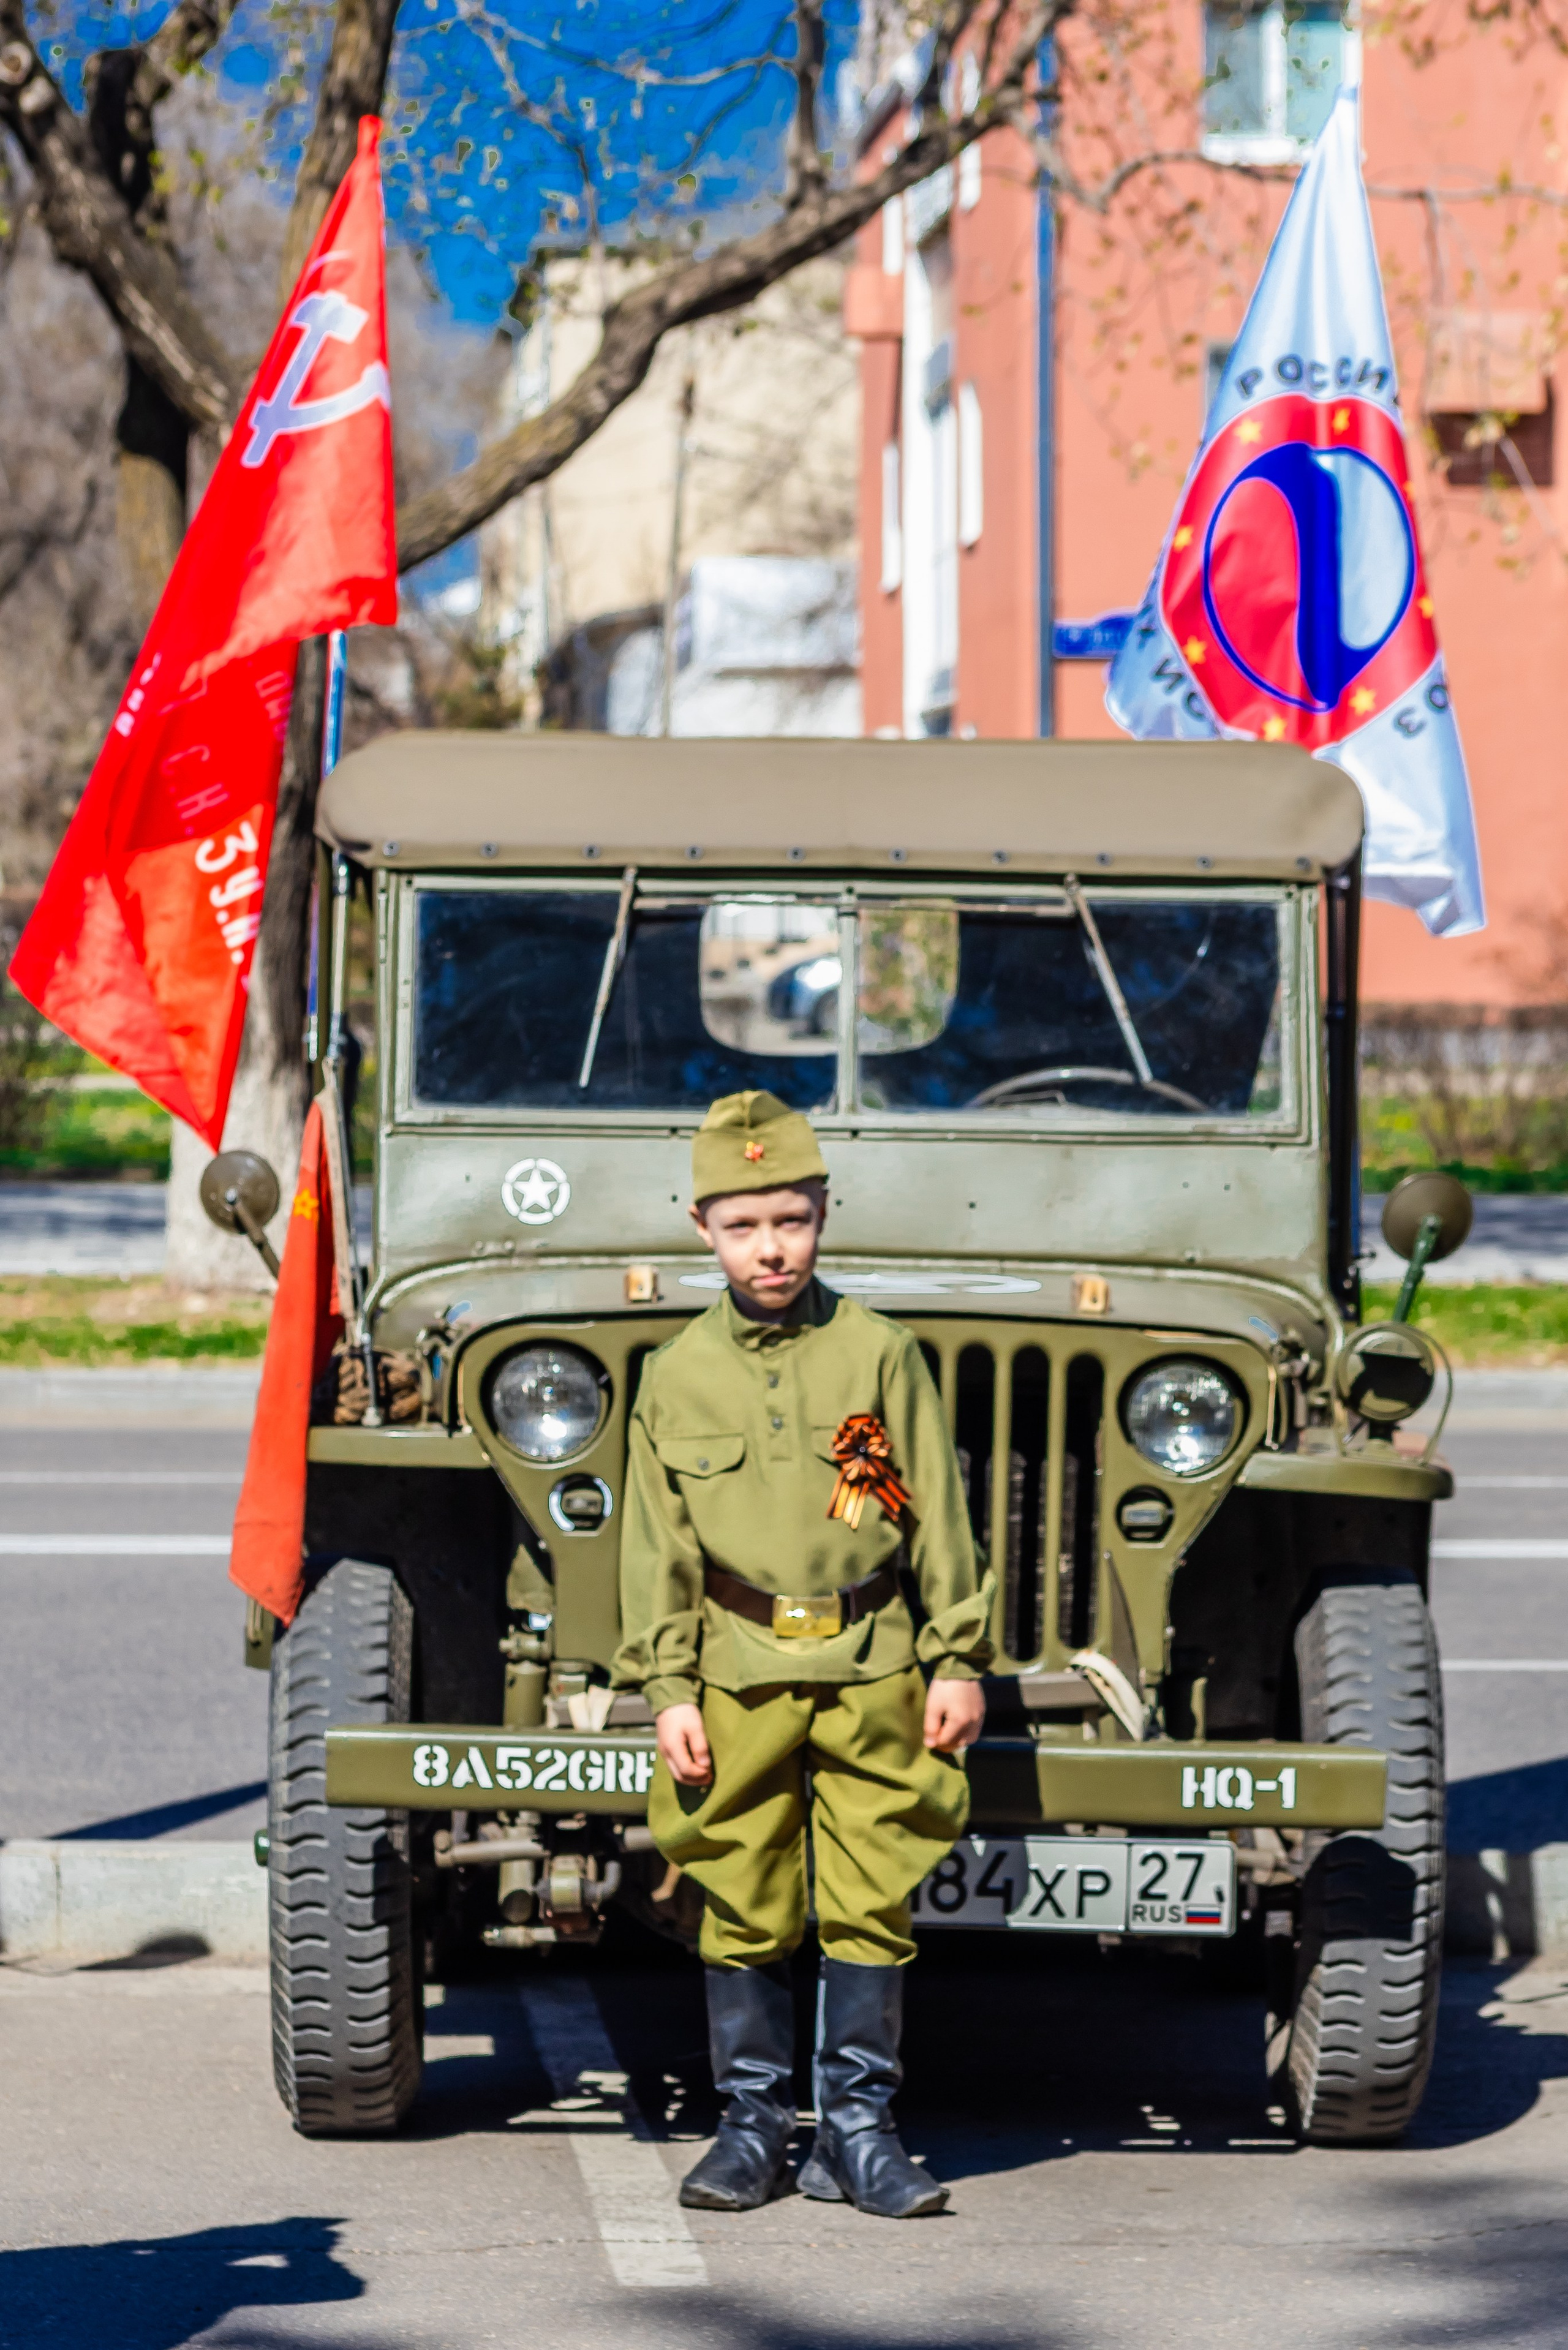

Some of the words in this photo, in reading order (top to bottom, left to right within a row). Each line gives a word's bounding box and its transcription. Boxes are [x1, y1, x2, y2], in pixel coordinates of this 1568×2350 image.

[1237, 355, 1398, 407] РОССИ
[1182, 1766, 1297, 1810] HQ-1
[1139, 1851, 1205, 1902] 27
[1133, 1904, 1183, 1923] RUS
